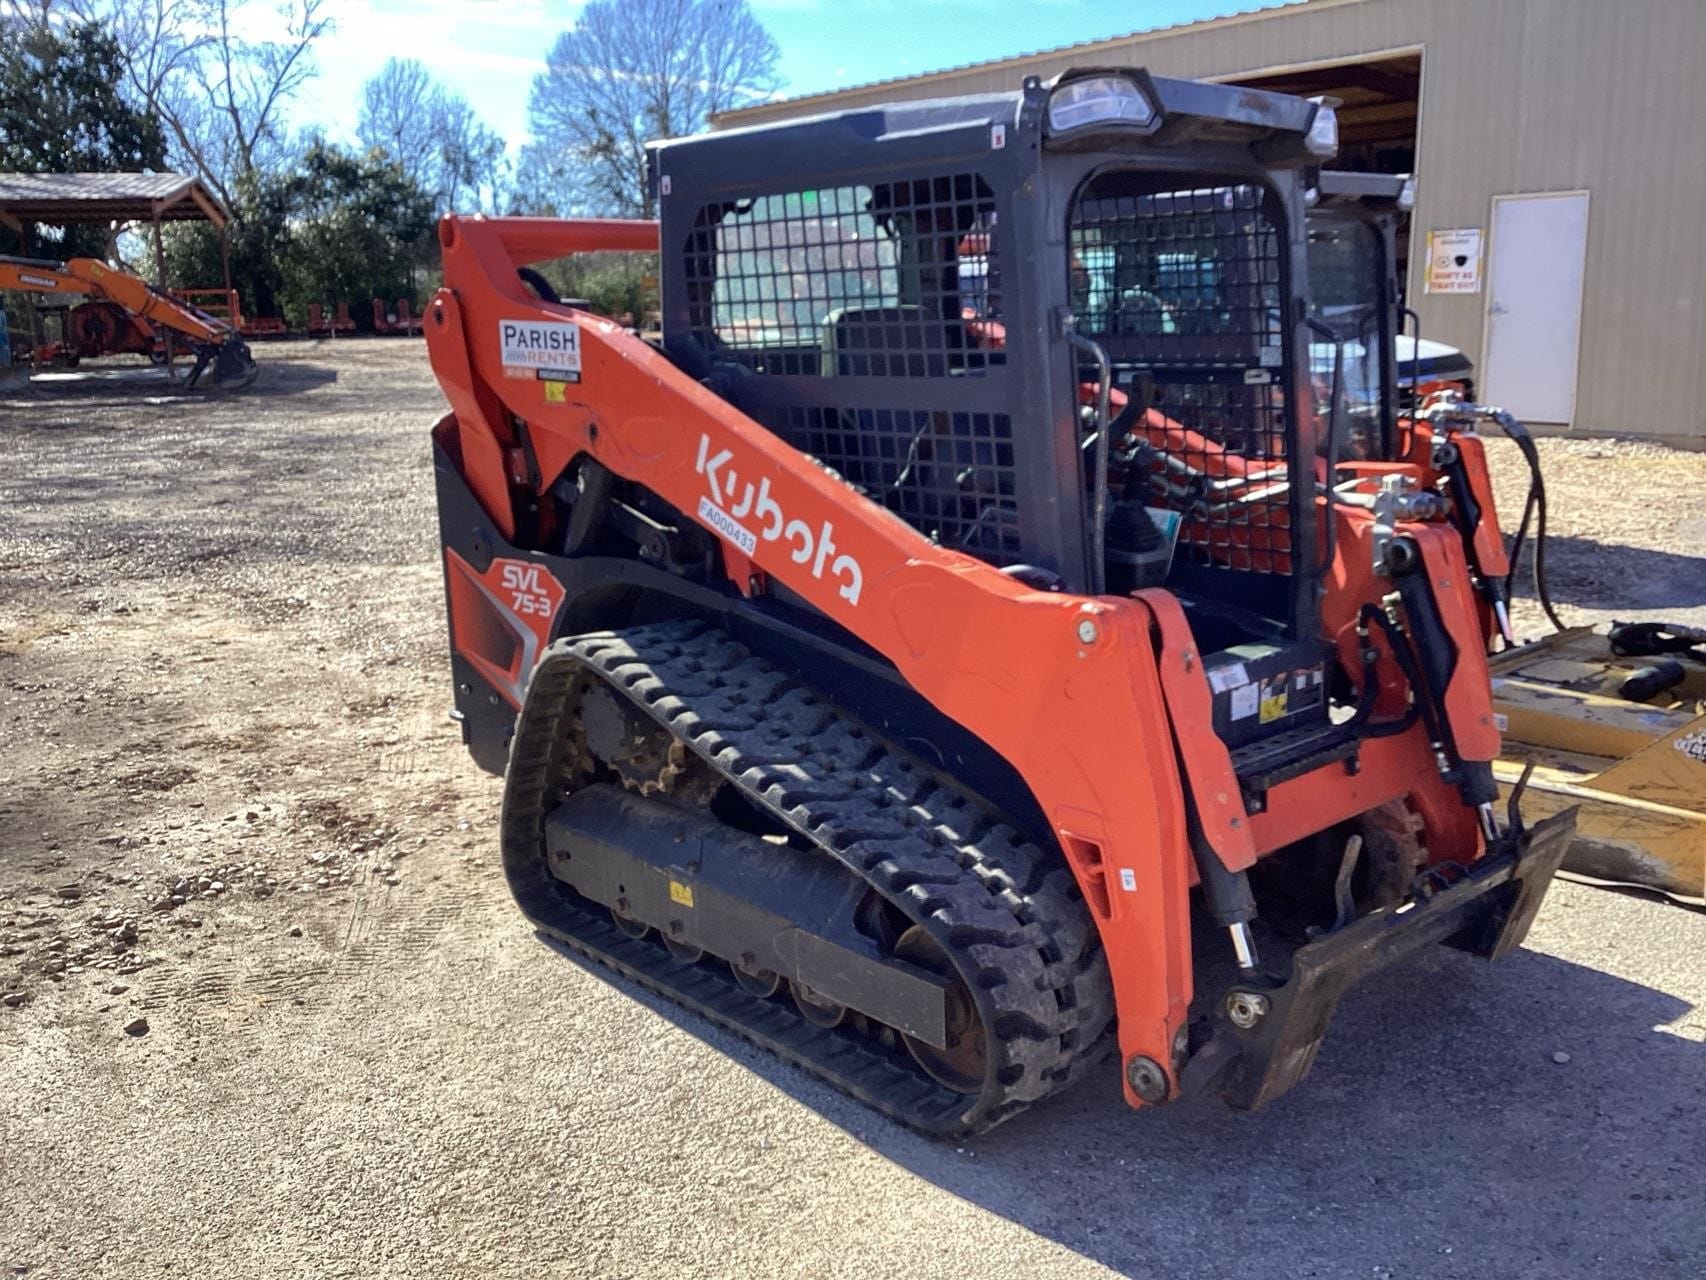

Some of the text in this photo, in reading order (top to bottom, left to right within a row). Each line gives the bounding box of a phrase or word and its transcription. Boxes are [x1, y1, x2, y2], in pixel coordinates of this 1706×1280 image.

[504, 324, 575, 351] PARISH
[527, 351, 577, 365] RENTS
[695, 432, 863, 608] Kubota
[700, 500, 756, 554] FA000433
[501, 564, 548, 595] SVL
[511, 590, 551, 617] 75-3
